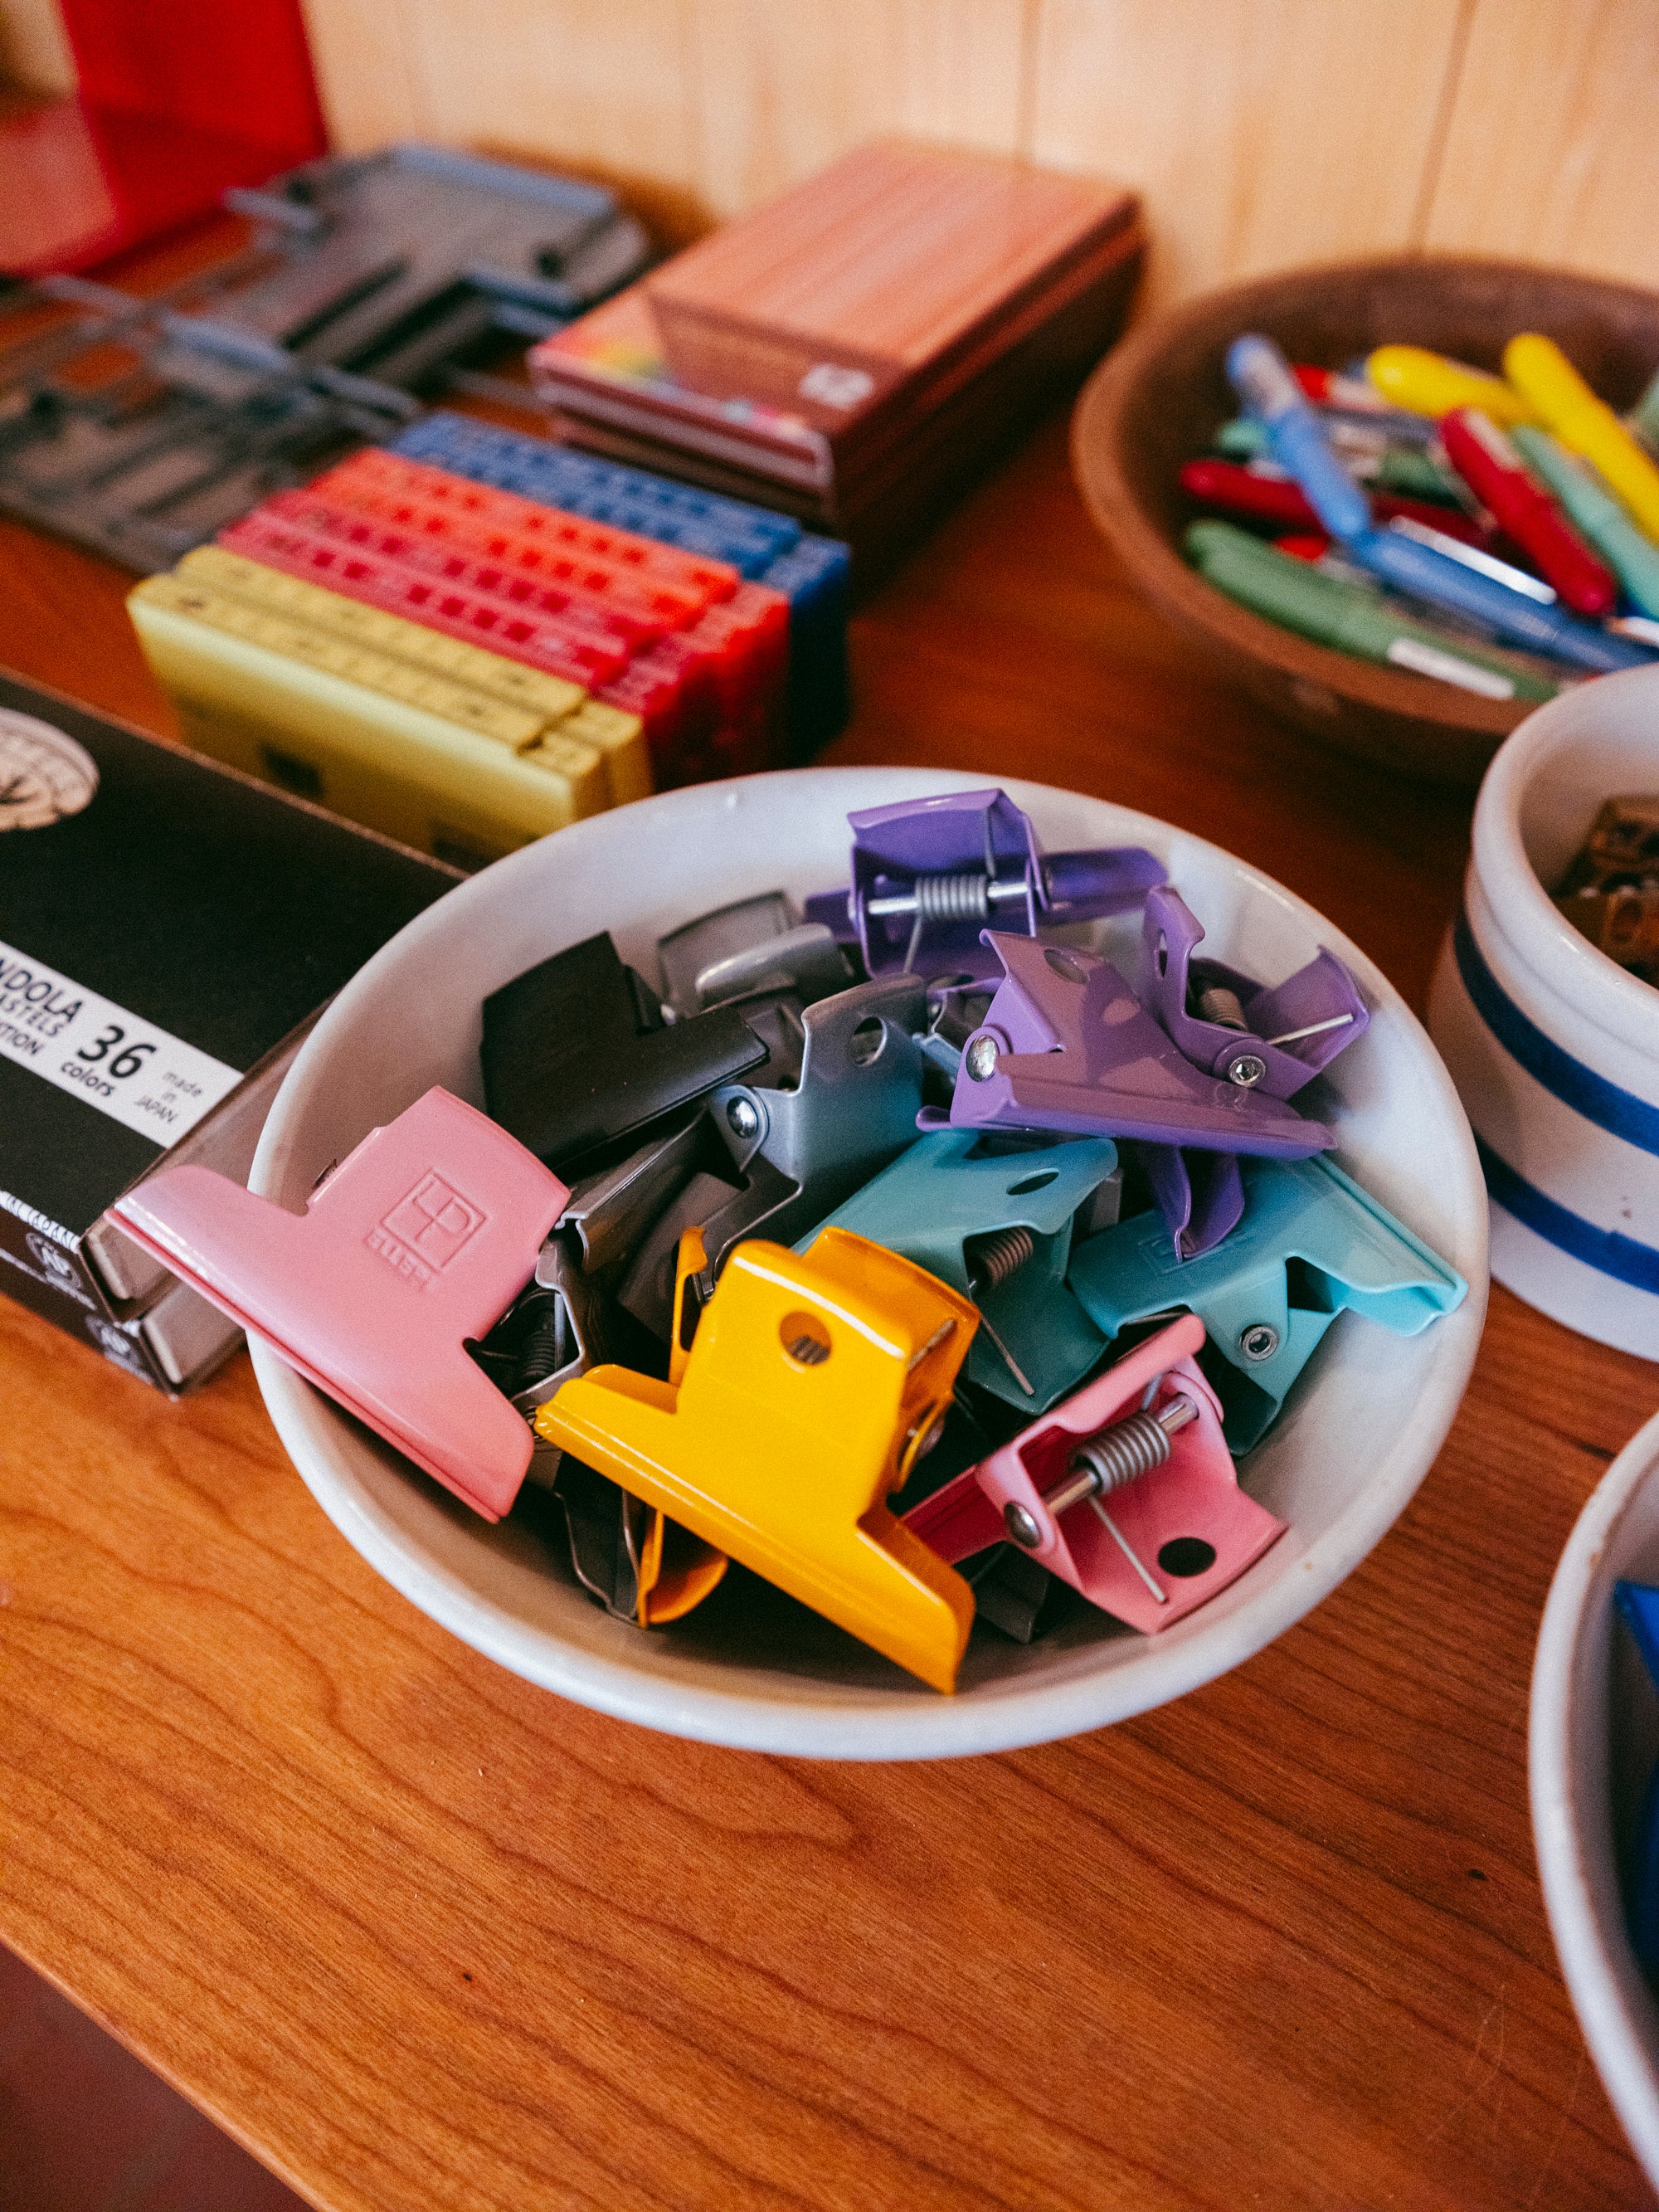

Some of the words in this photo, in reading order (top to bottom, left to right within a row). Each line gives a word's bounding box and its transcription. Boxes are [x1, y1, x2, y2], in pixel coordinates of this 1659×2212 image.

[78, 1025, 156, 1079] 36
[61, 1060, 114, 1097] colors
[163, 1071, 205, 1097] made
[134, 1095, 178, 1123] JAPAN
[162, 1091, 177, 1103] in
